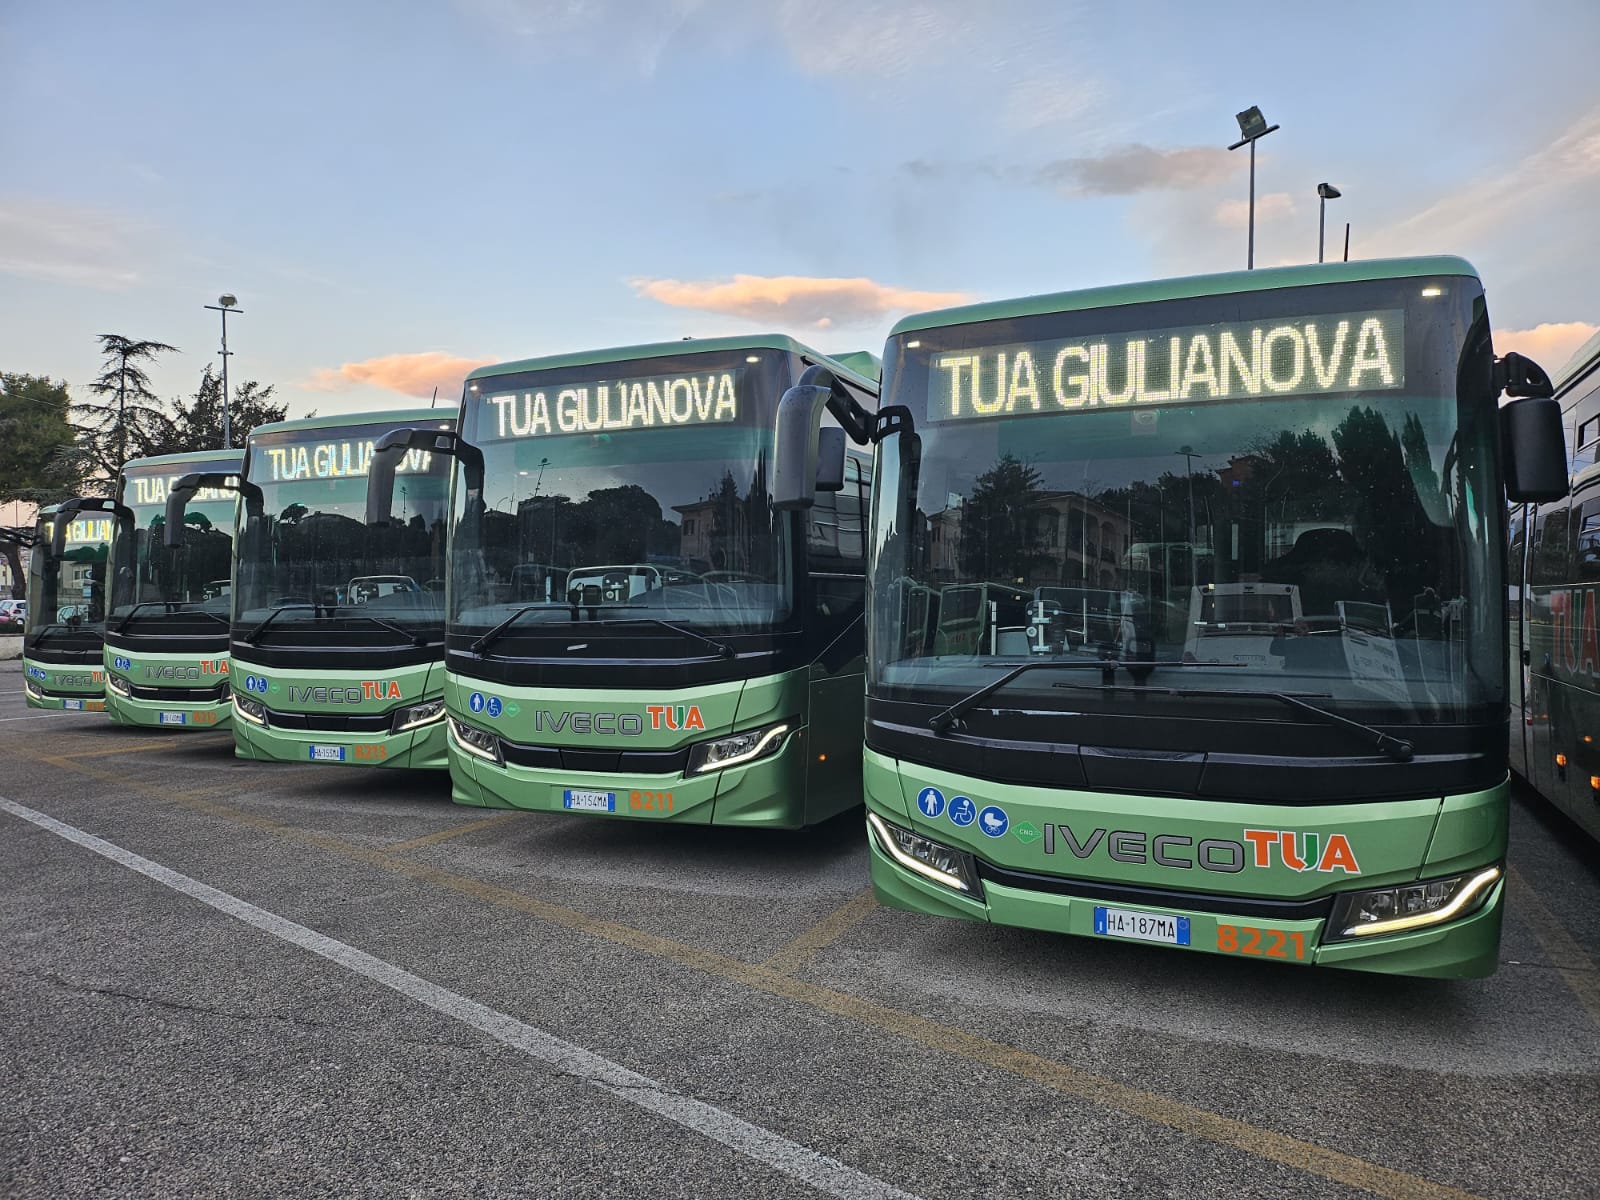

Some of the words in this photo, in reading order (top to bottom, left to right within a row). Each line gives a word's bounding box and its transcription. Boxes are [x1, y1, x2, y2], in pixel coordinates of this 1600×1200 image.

[940, 350, 1041, 416] TUA
[1053, 317, 1395, 408] GIULIANOVA
[491, 391, 552, 437] TUA
[556, 373, 738, 433] GIULIANOVA
[268, 446, 310, 480] TUA
[134, 477, 166, 504] TUA
[45, 521, 71, 542] TA
[1549, 588, 1600, 679] TUA
[145, 665, 200, 680] IVECO
[200, 659, 230, 675] TUA
[288, 685, 362, 705] IVECO
[361, 680, 403, 701] TUA
[535, 711, 643, 737] IVECO
[645, 705, 705, 731] TUA
[630, 790, 673, 812] 8211
[1043, 823, 1245, 875] IVECO
[1243, 829, 1362, 876] TUA
[1217, 923, 1305, 961] 8221
